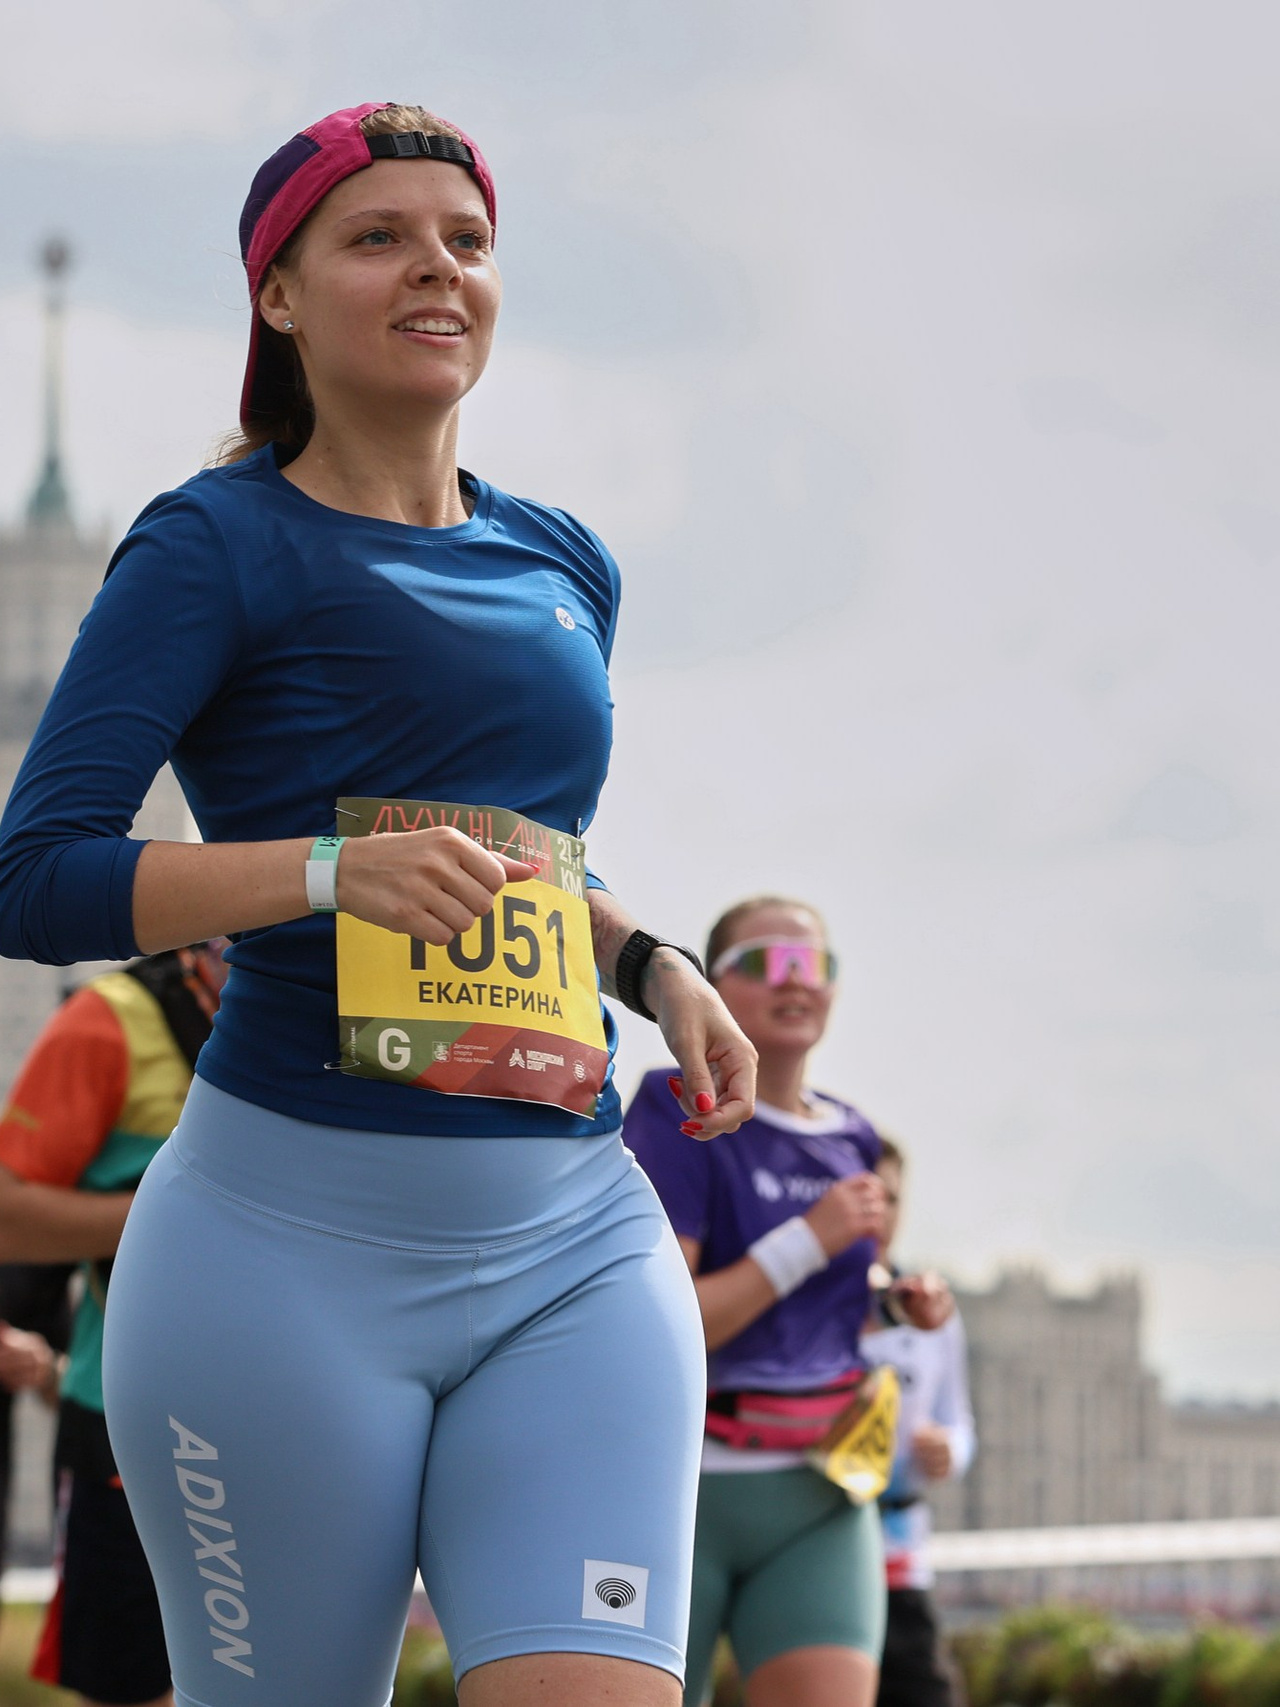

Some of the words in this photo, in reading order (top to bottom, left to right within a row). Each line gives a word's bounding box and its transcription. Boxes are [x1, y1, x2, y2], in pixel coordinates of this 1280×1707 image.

[419, 981, 564, 1020] ЕКАТЕРИНА
[378, 1028, 412, 1071] G
[168, 1414, 255, 1679] ADIXION
